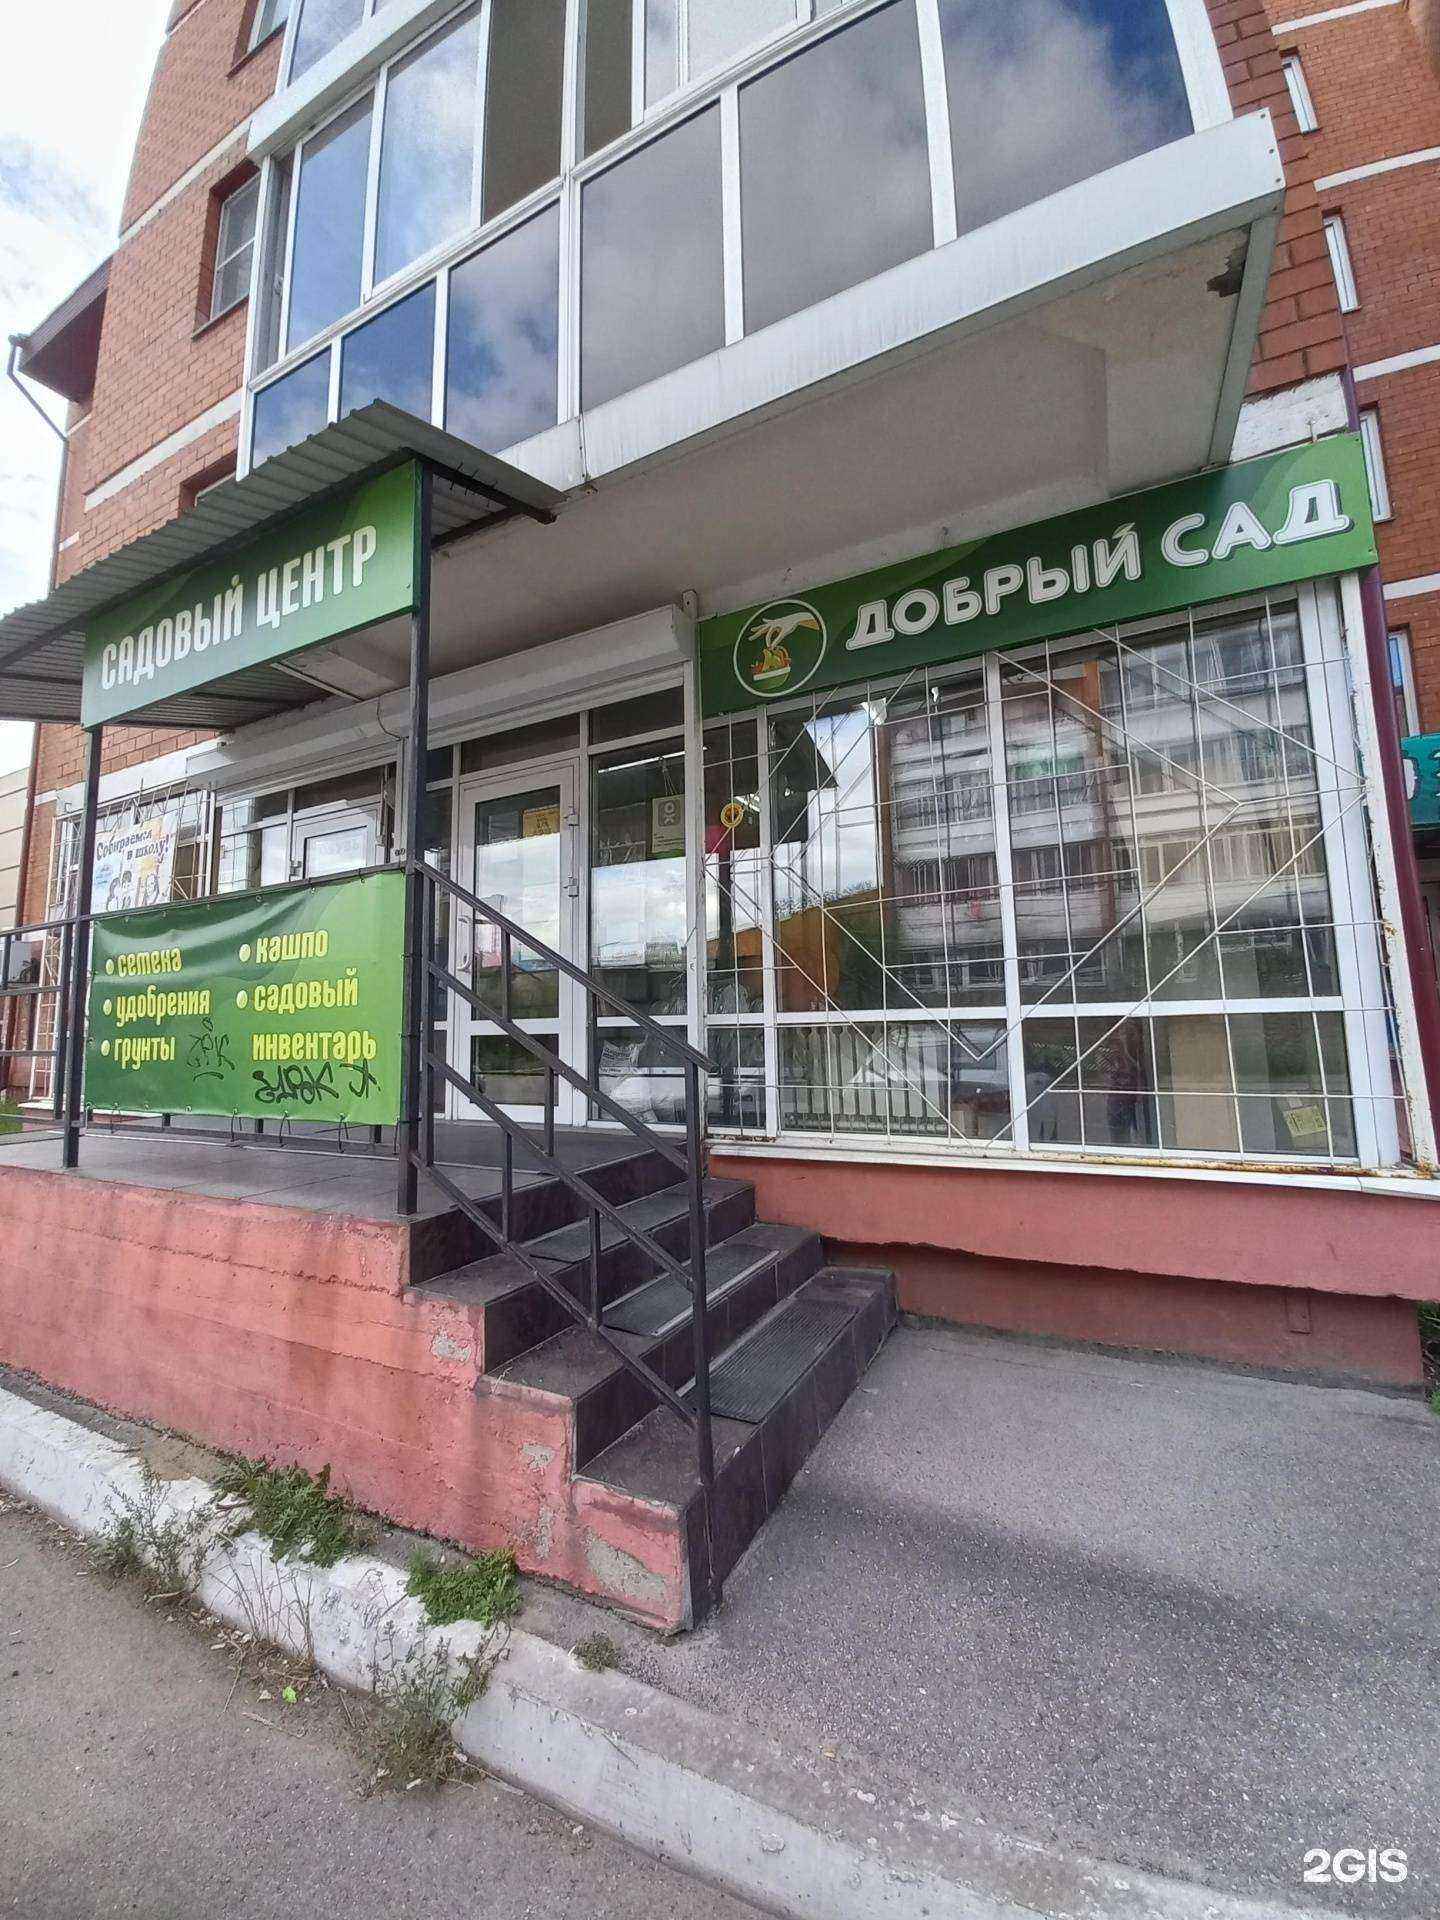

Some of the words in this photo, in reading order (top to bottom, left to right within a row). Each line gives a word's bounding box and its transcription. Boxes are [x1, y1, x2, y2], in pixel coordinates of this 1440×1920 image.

[845, 522, 1142, 651] ДОБРЫЙ
[1161, 478, 1354, 568] САД
[101, 574, 244, 690] САДОВЫЙ
[255, 525, 378, 629] ЦЕНТР
[117, 947, 182, 977] семена
[255, 929, 329, 964] кашпо
[115, 985, 211, 1027] удобрения
[253, 967, 359, 1015] садовый
[114, 1036, 176, 1070] грунты
[252, 1030, 377, 1067] инвентарь
